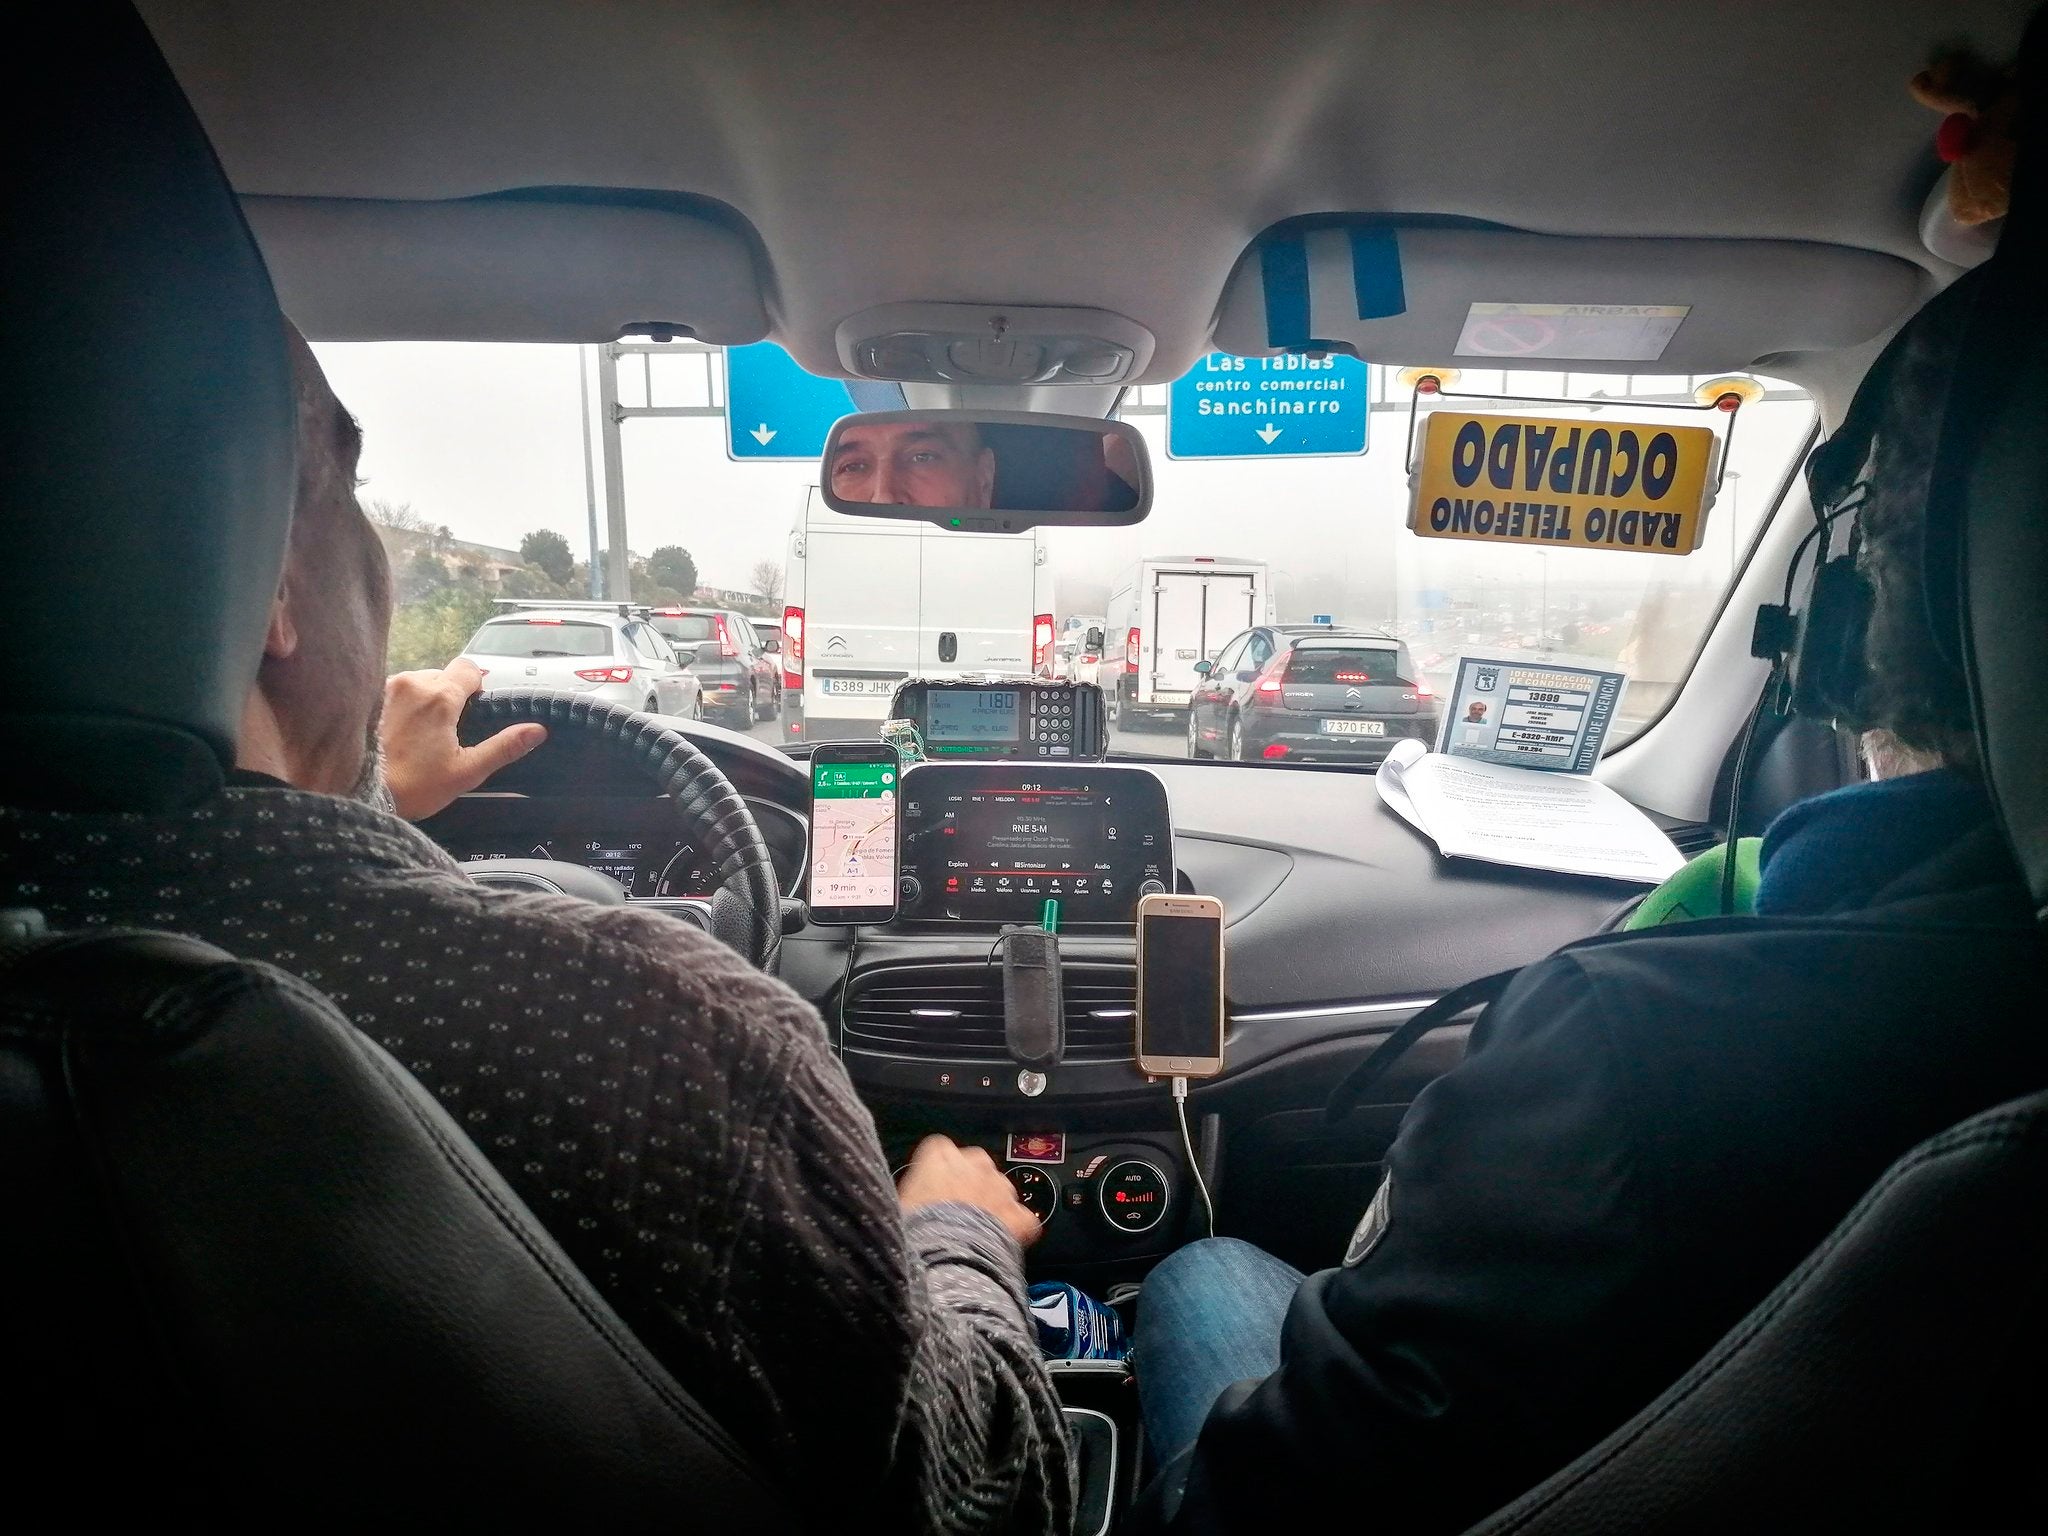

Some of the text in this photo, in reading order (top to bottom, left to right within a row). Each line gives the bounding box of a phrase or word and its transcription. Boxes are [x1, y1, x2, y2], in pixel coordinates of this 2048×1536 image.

[1206, 354, 1246, 372] Las
[1196, 377, 1346, 392] centro comercial
[1198, 397, 1341, 415] Sanchinarro
[1452, 421, 1678, 501] OCUPADO
[1431, 497, 1682, 549] RADIO TELEFONO
[832, 680, 891, 693] 6389 JHK
[1509, 678, 1592, 691] DE CONDUCTOR
[1328, 721, 1382, 734] 7370 FKZ
[1576, 677, 1618, 771] TITULAR DE LICENCIA
[1021, 783, 1041, 792] 09:12
[1012, 824, 1048, 834] RNE 5-M
[947, 860, 969, 869] Explora
[1020, 861, 1047, 869] Sintonizar
[1094, 862, 1111, 870] Audio
[830, 884, 839, 892] 19
